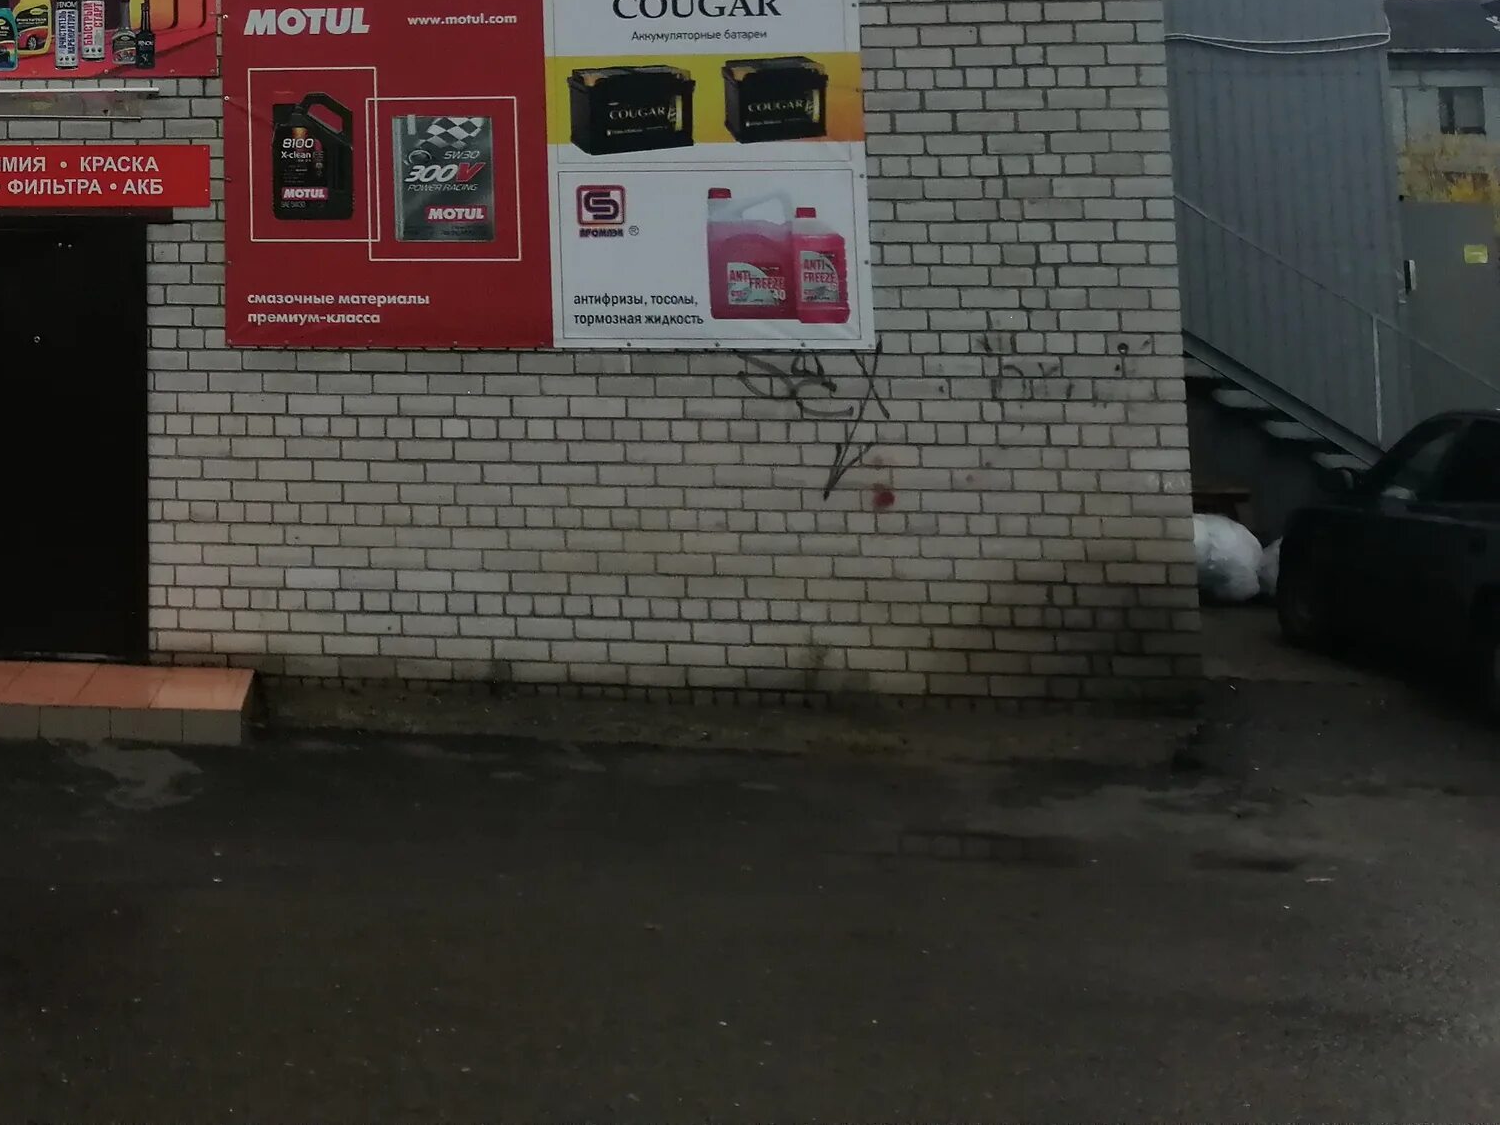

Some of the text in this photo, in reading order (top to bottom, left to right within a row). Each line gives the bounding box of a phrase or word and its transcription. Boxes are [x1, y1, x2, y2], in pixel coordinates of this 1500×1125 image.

[94, 3, 103, 28] СТАРТ
[243, 7, 517, 36] MOTUL www.motul.com
[631, 29, 767, 43] Аккумуляторные батареи
[609, 106, 666, 120] COUGAR
[282, 138, 314, 148] 8100
[281, 150, 311, 159] X-clean
[444, 150, 480, 160] 5W30
[79, 156, 159, 172] КРАСКА
[404, 162, 486, 183] 300V
[7, 178, 102, 195] ФИЛЬТРА
[122, 178, 164, 195] АКБ
[283, 188, 325, 198] MOTUL
[407, 183, 479, 192] POWER RACING
[427, 207, 485, 220] MOTUL
[247, 293, 430, 307] смазочные материалы
[573, 292, 699, 307] антифризы, тосолы,
[247, 312, 381, 325] премиум-класса
[573, 312, 704, 326] тормозная жидкость
